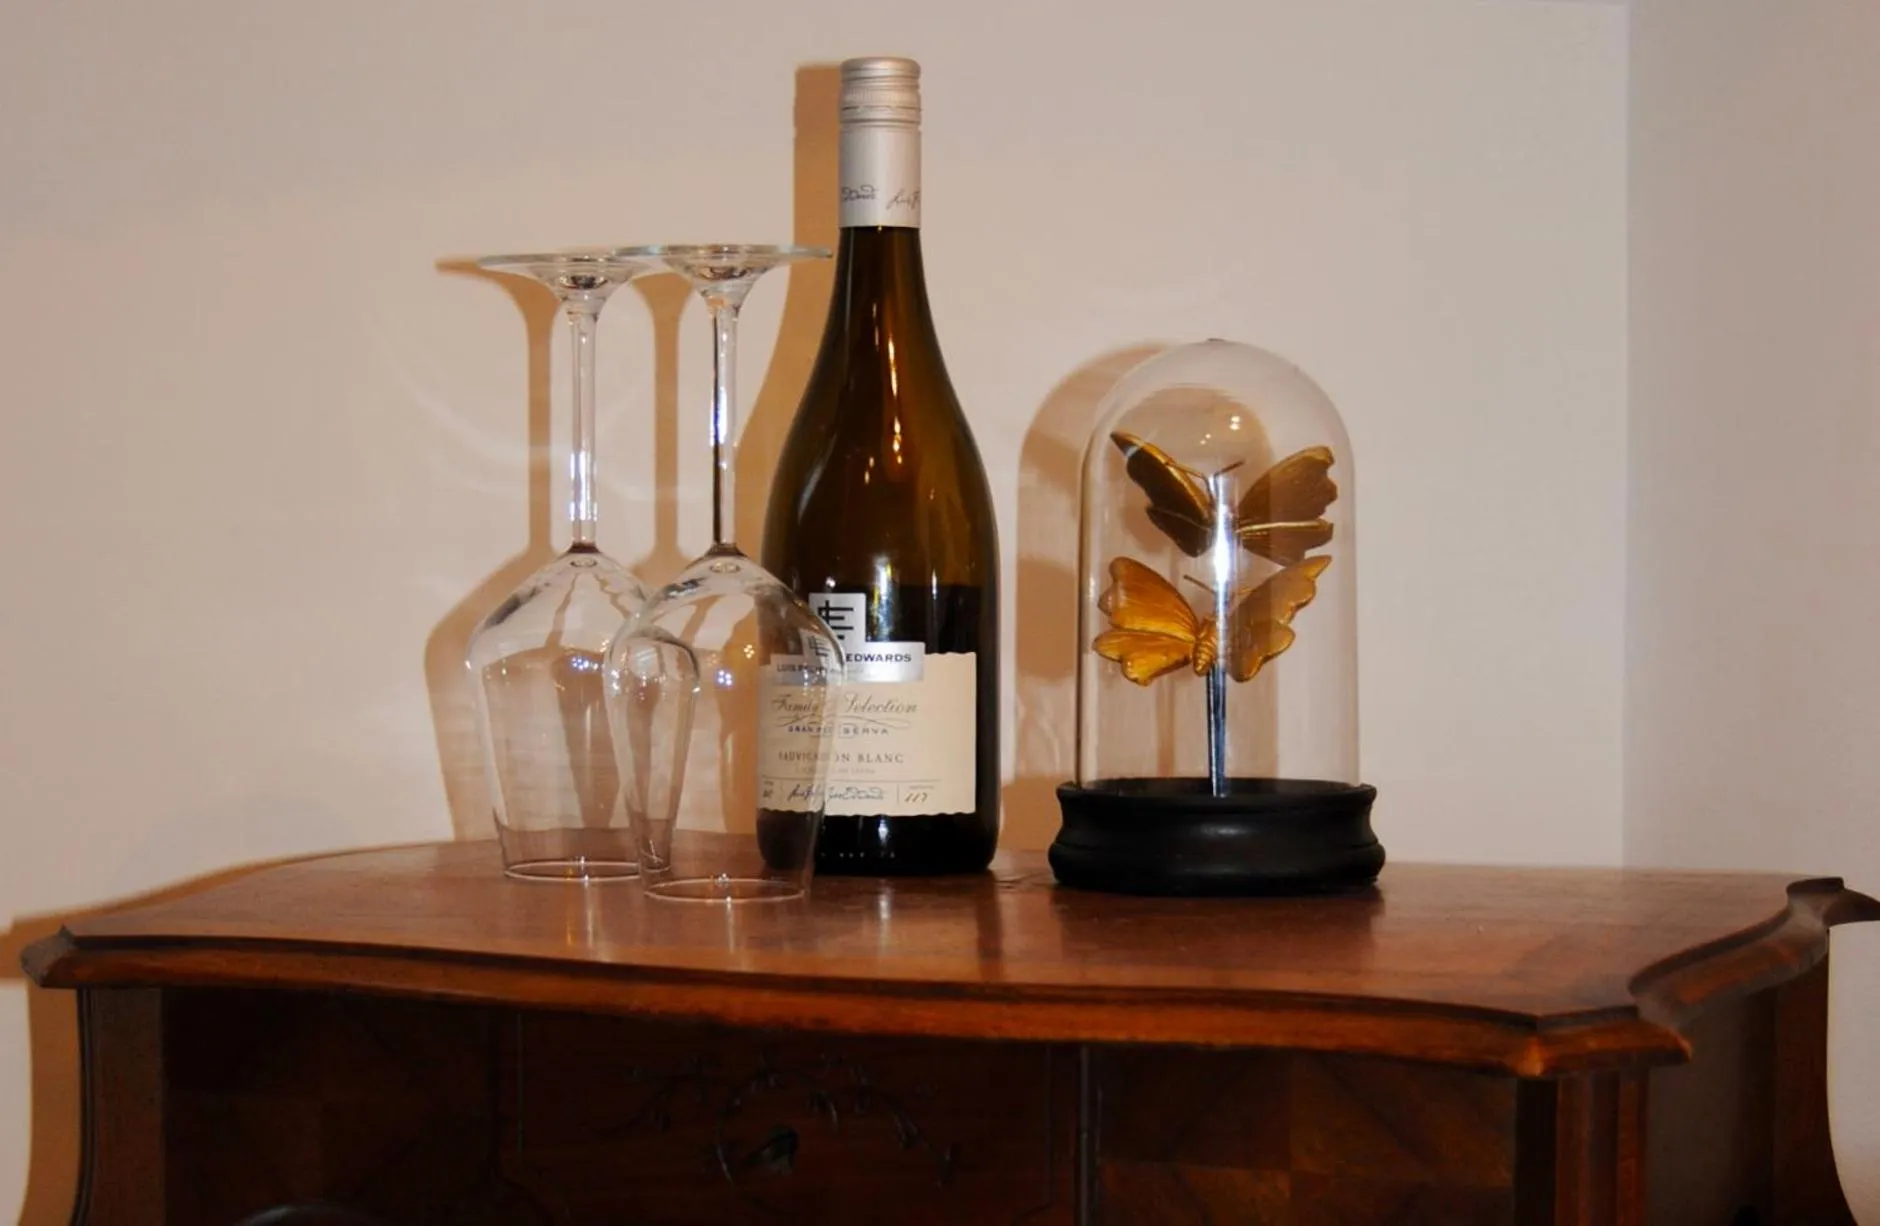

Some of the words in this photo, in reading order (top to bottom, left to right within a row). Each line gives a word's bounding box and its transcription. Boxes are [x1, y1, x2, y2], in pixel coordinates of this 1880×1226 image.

[845, 652, 912, 663] EDWARDS
[843, 691, 918, 713] Selection
[857, 752, 904, 764] BLANC
